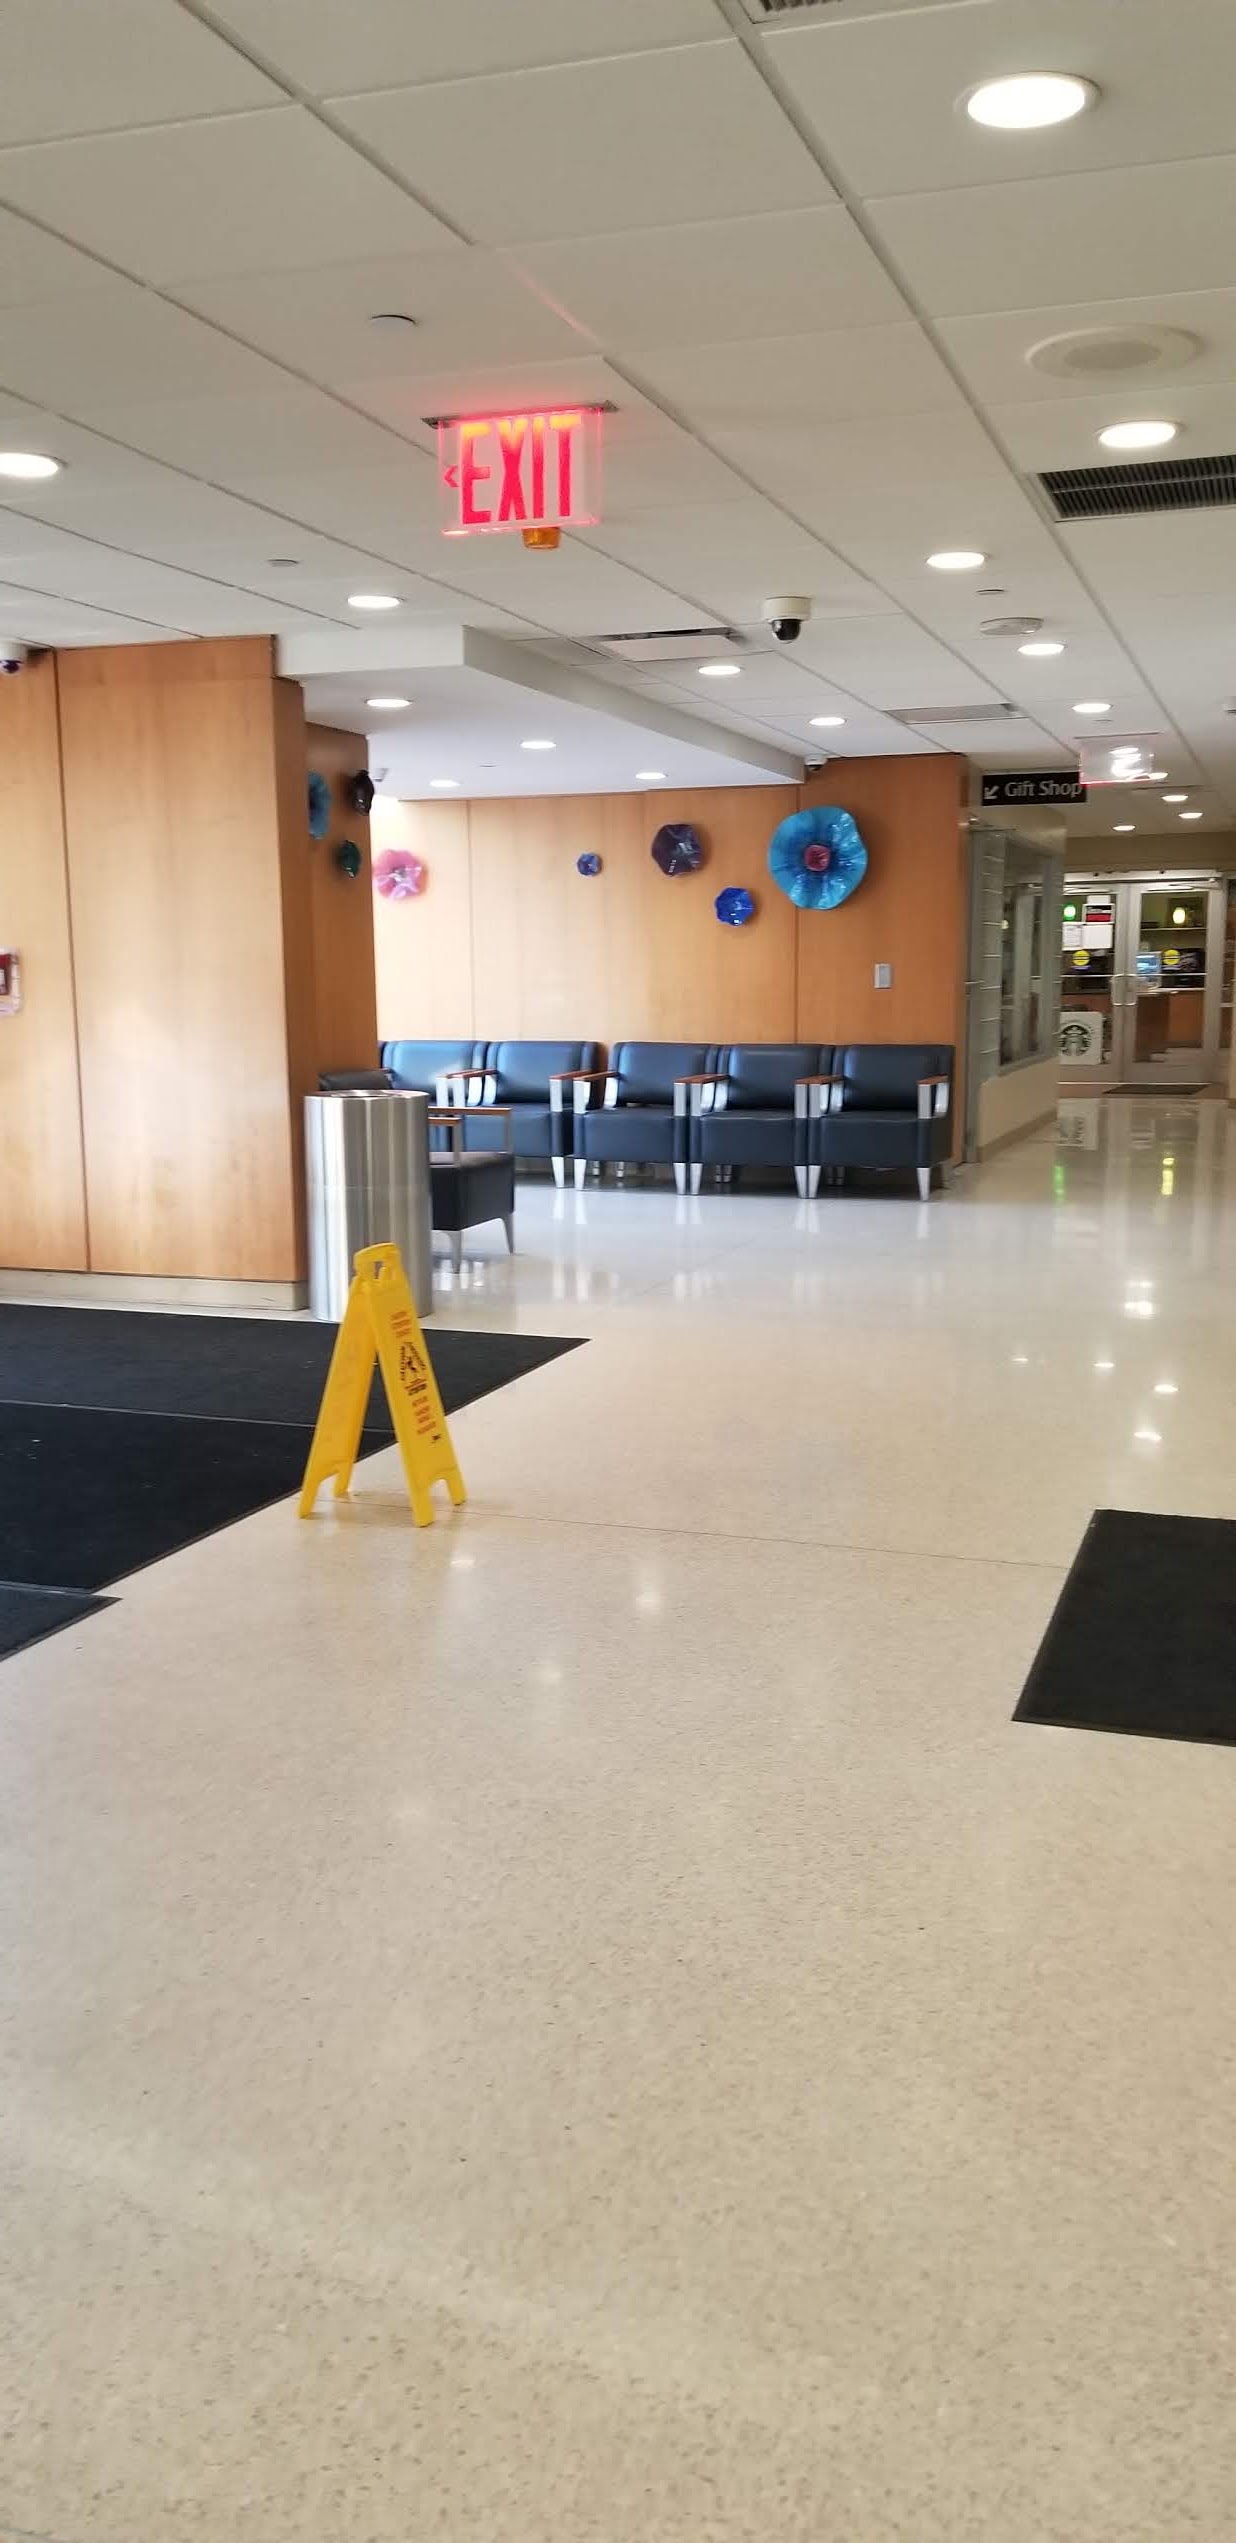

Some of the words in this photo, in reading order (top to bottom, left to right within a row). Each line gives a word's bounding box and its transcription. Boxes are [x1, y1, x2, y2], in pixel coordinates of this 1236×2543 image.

[462, 415, 581, 524] EXIT
[1005, 782, 1034, 797] Gift
[1038, 780, 1081, 798] Shop
